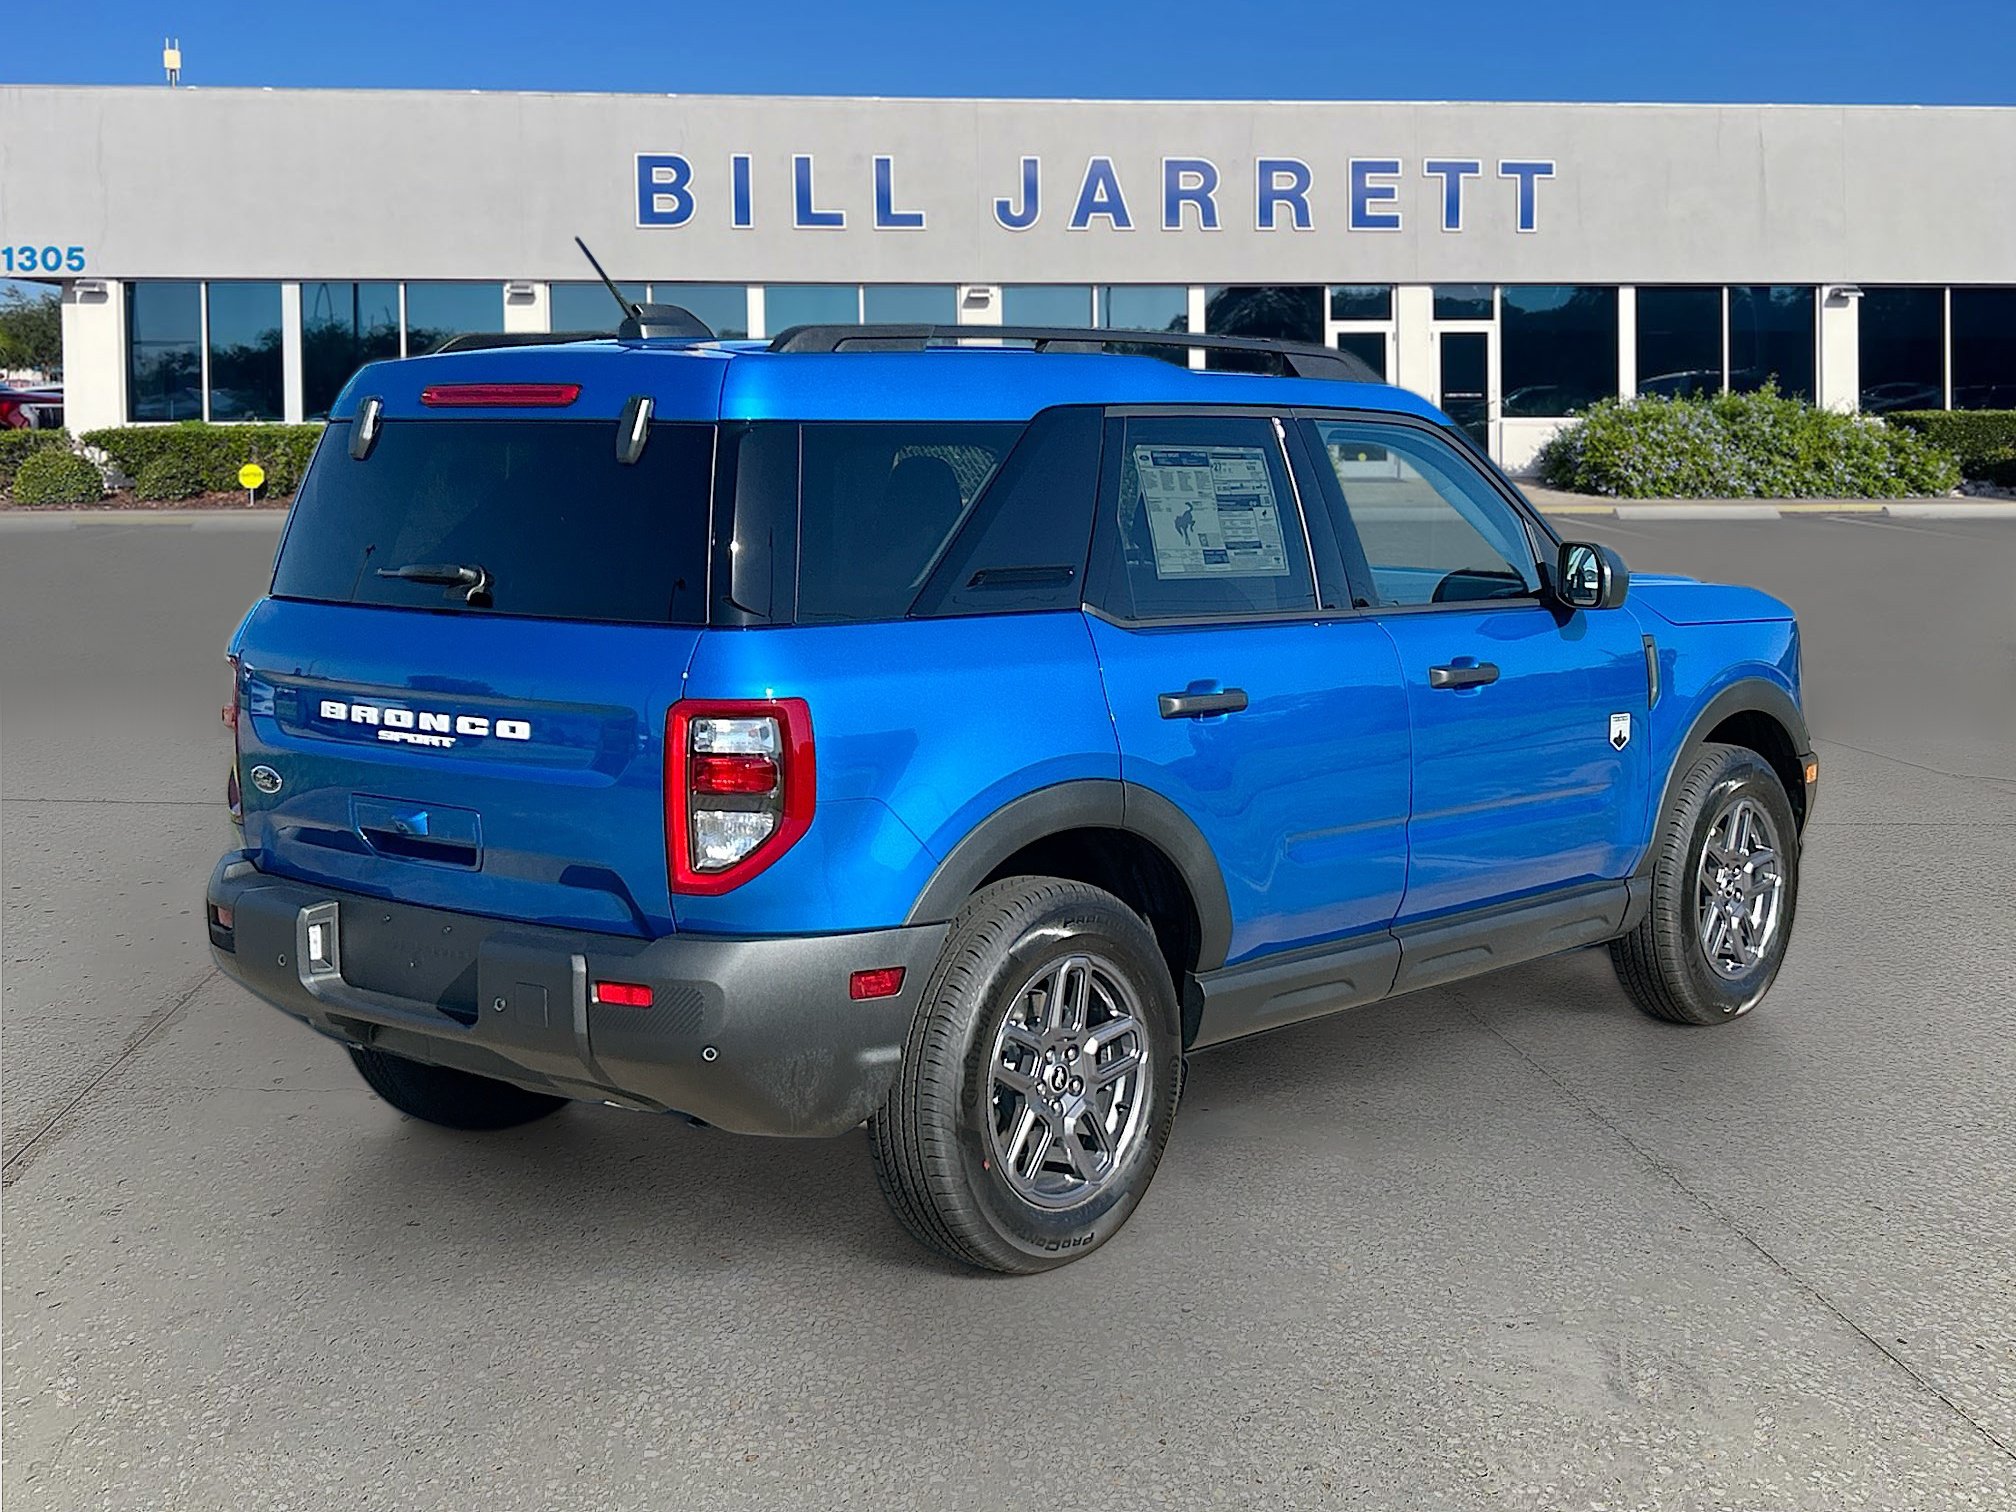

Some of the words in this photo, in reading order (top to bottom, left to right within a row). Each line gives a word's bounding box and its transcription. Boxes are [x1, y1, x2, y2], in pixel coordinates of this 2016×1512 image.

[634, 153, 925, 230] BILL
[994, 156, 1556, 233] JARRETT
[1, 246, 86, 272] 1305
[320, 700, 531, 740] BRONCO
[377, 729, 456, 748] SPORT
